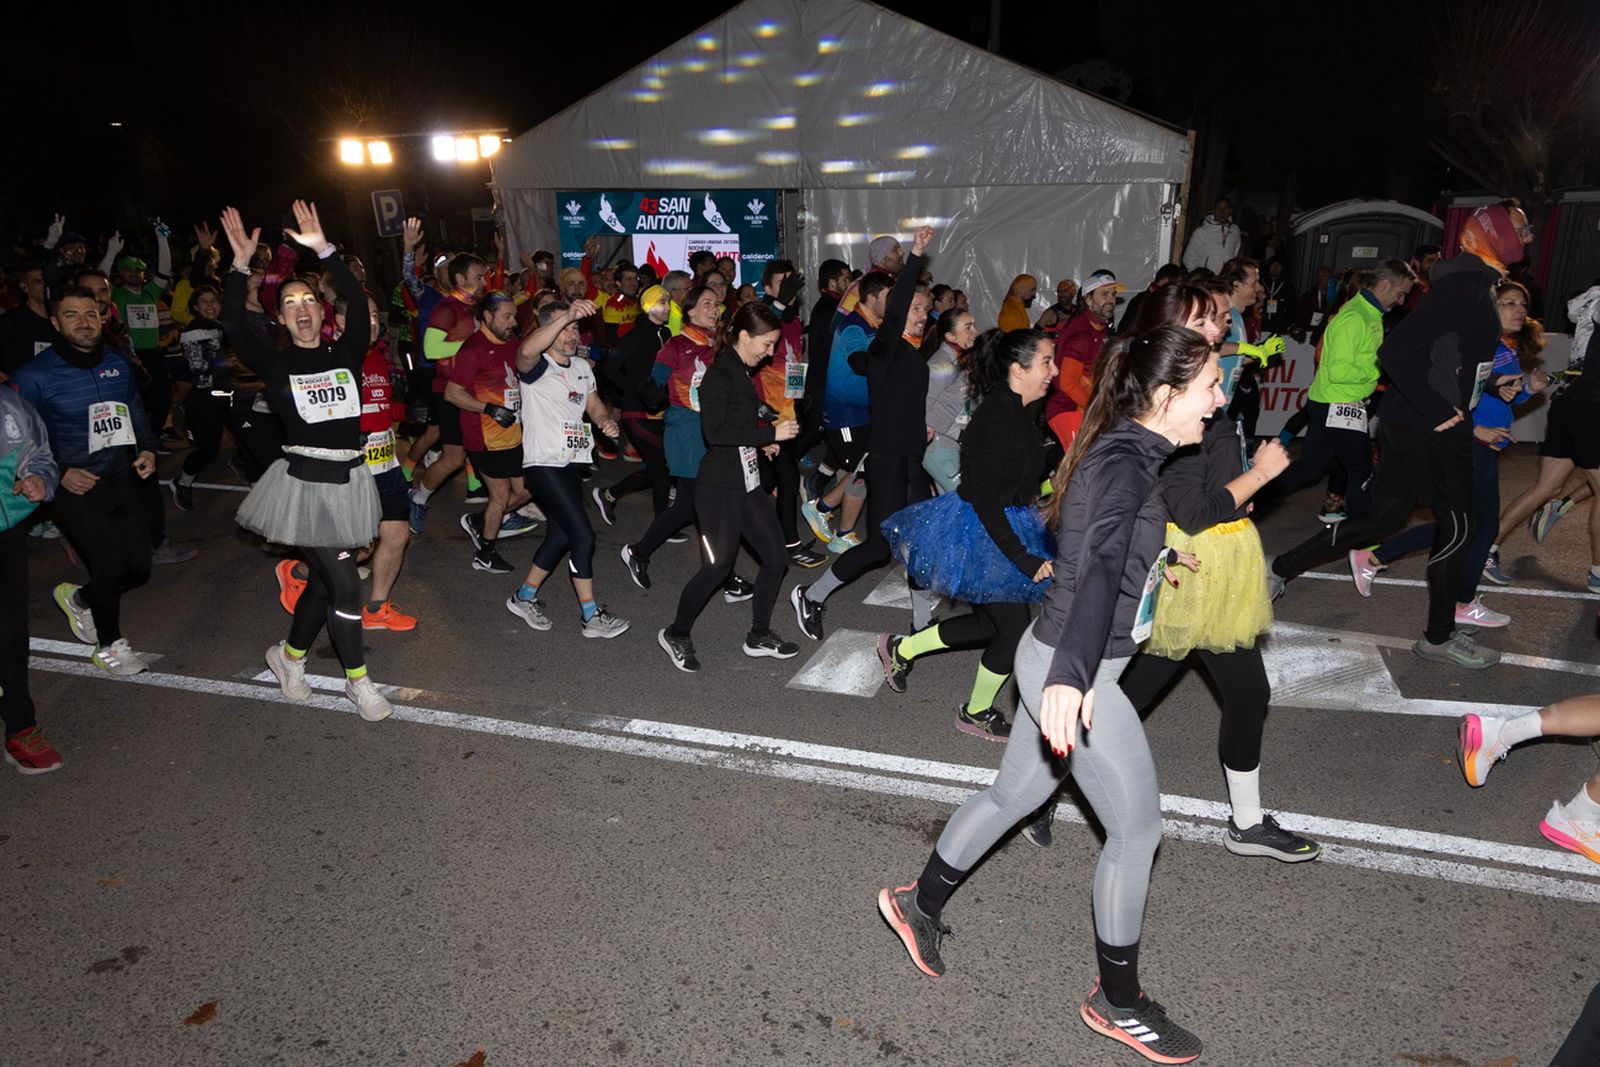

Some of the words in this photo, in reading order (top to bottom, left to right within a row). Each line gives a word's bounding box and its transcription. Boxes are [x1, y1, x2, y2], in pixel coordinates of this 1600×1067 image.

[639, 197, 658, 214] 43
[658, 197, 691, 213] SAN
[379, 196, 398, 230] P
[636, 210, 689, 230] ANTÓN
[606, 215, 618, 227] 43
[711, 215, 722, 227] 43
[741, 252, 775, 260] calderón
[98, 368, 120, 379] FILA
[307, 385, 347, 405] 3079
[1335, 405, 1362, 420] 3662
[93, 416, 122, 435] 4416
[566, 435, 590, 449] 5505
[1467, 608, 1485, 620] N
